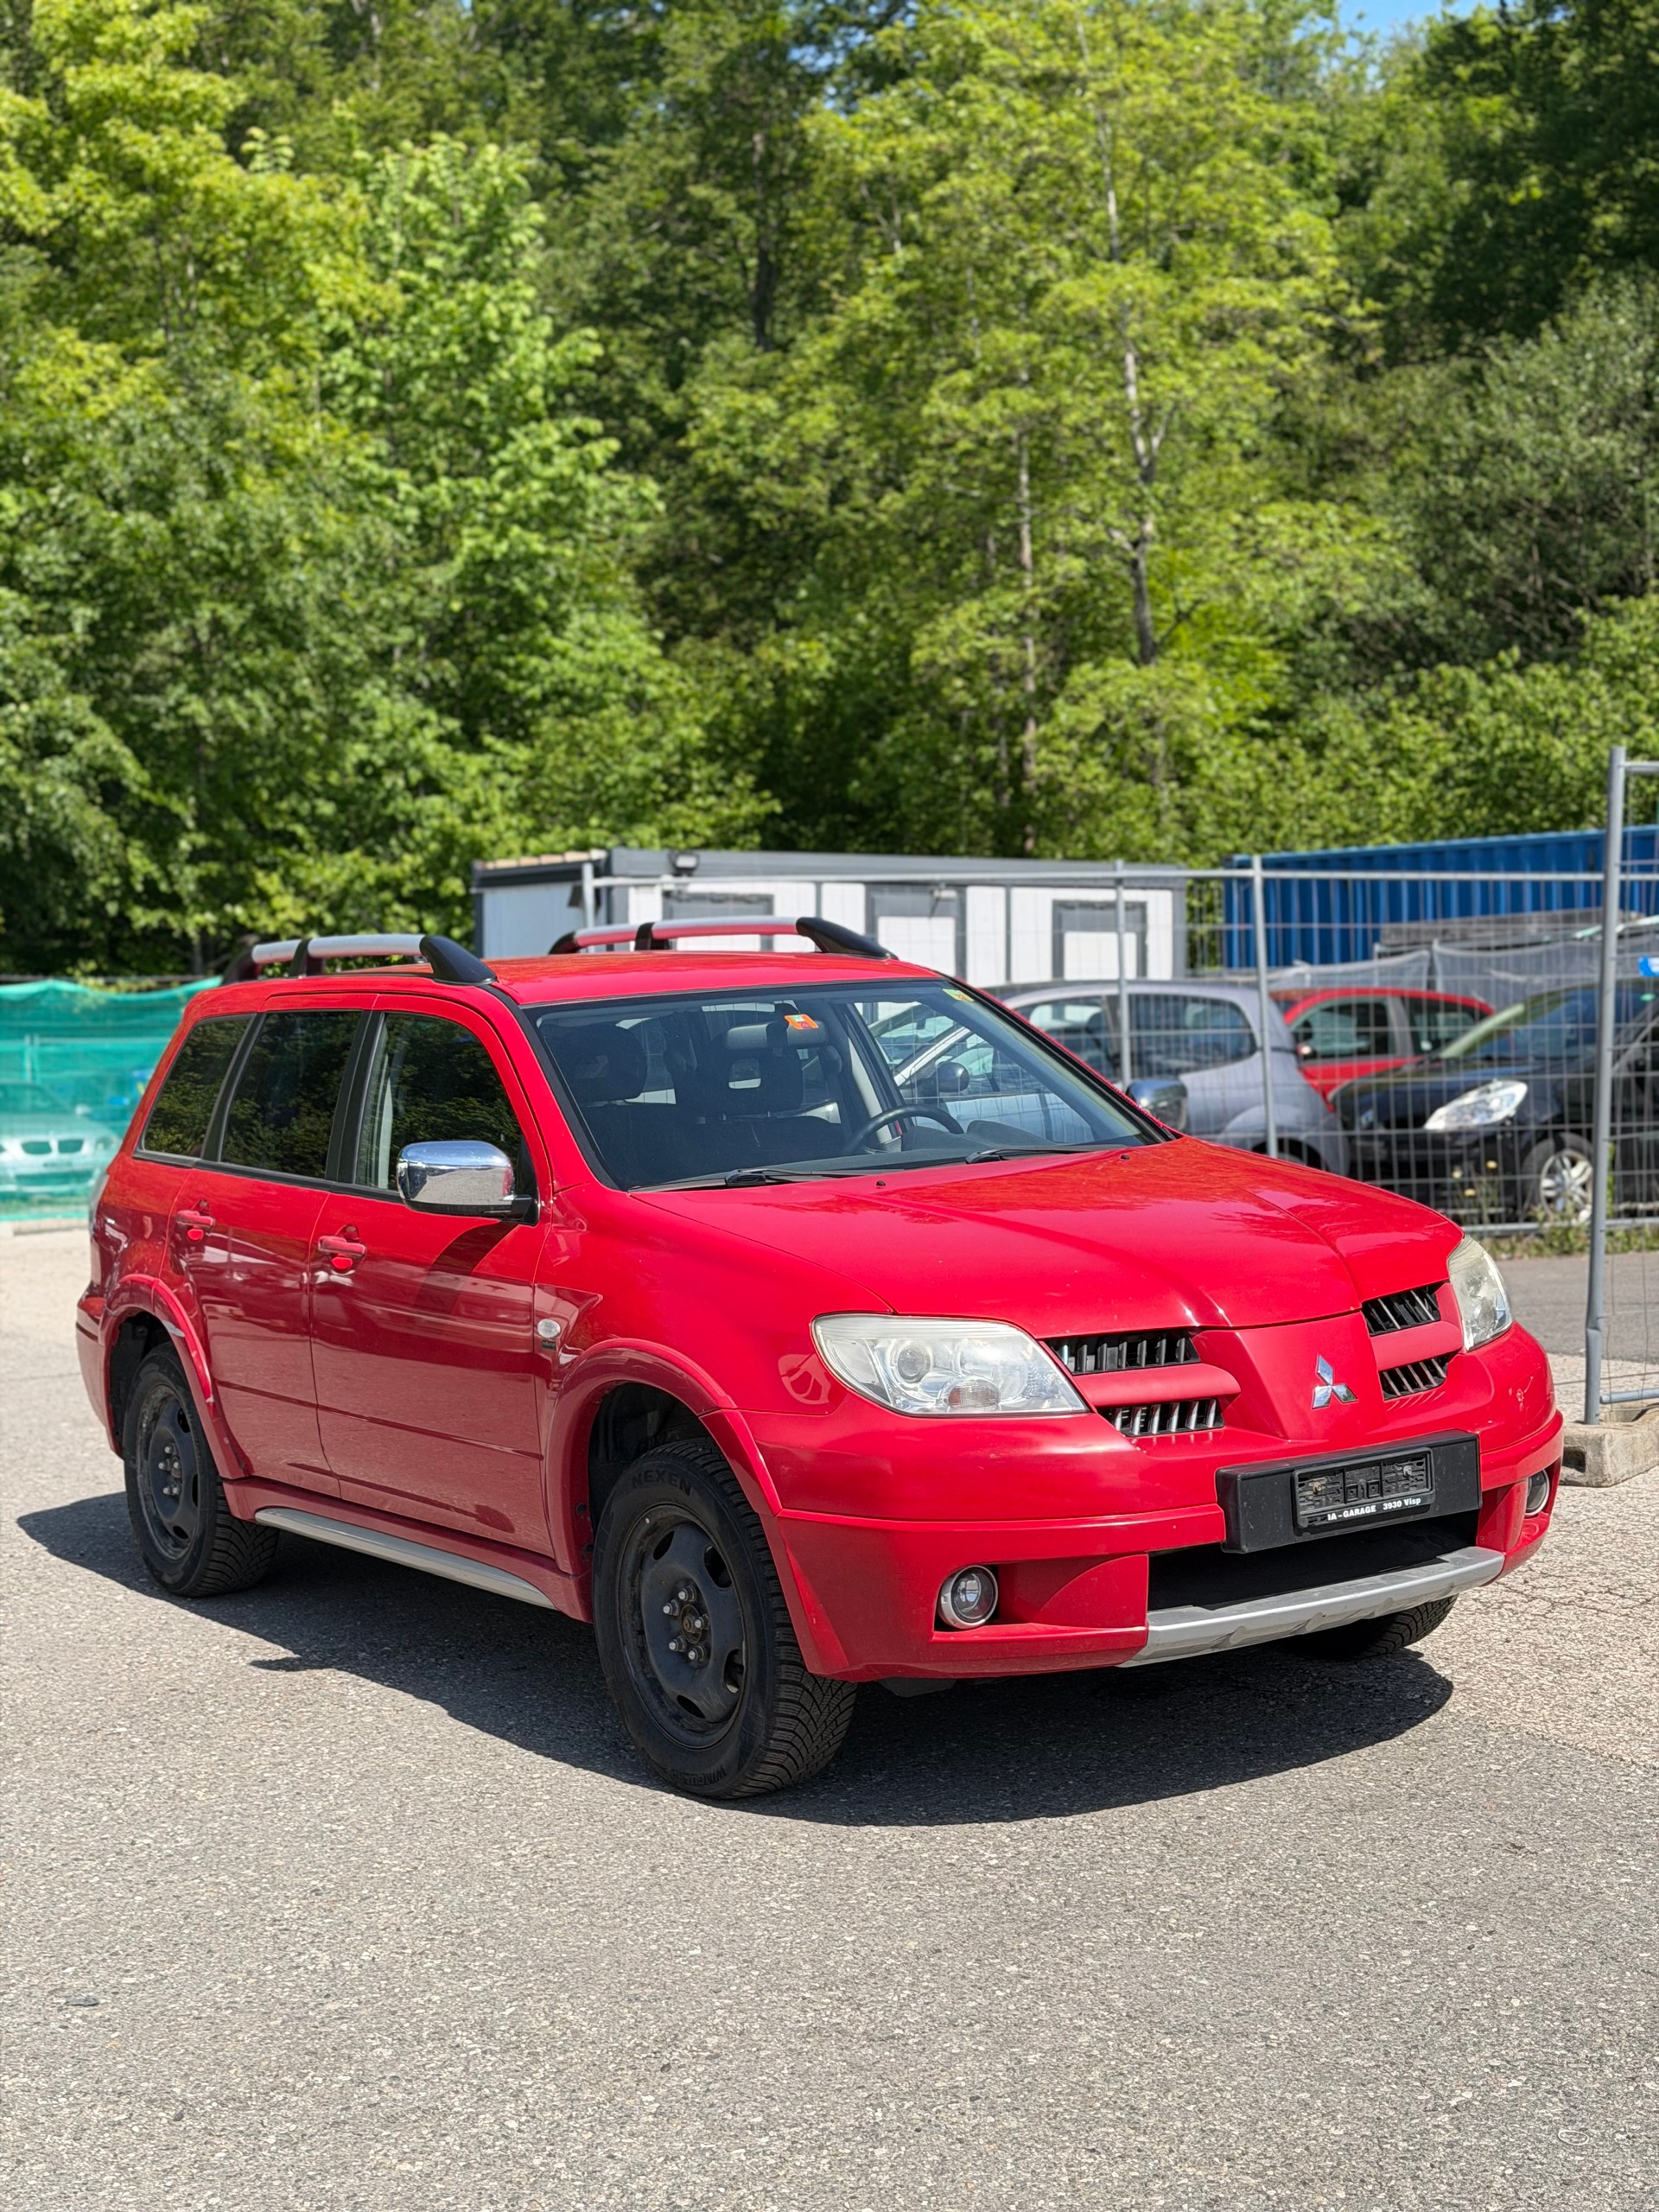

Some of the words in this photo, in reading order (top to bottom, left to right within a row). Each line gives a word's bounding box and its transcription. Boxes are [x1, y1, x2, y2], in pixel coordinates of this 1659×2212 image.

[632, 1469, 692, 1497] NEXEN
[1382, 1501, 1402, 1510] 3930
[1403, 1497, 1421, 1506] Visp
